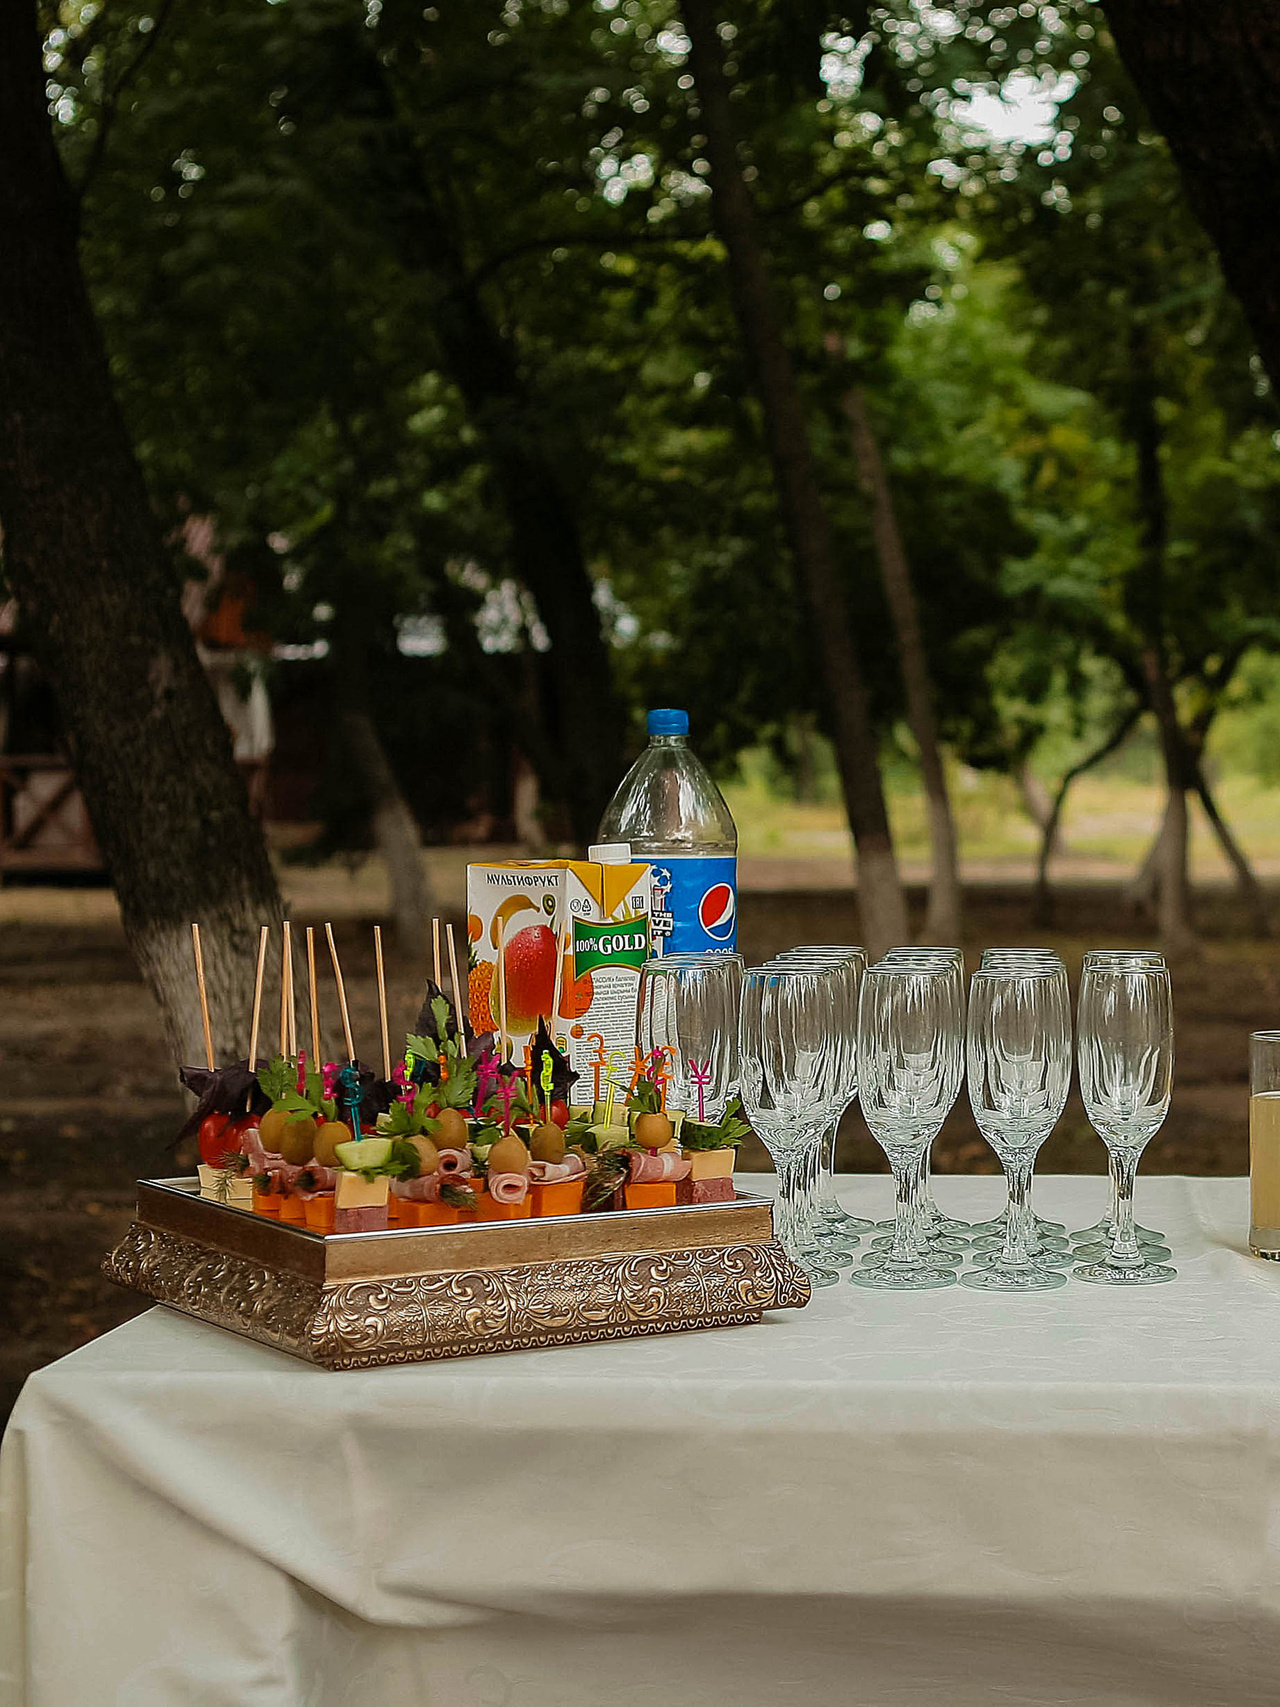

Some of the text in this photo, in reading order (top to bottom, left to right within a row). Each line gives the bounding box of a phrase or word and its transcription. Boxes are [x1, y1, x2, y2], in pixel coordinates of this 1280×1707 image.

[486, 873, 559, 886] МУЛЬТИФРУКТ
[651, 919, 671, 927] VE
[575, 933, 646, 955] 100% GOLD
